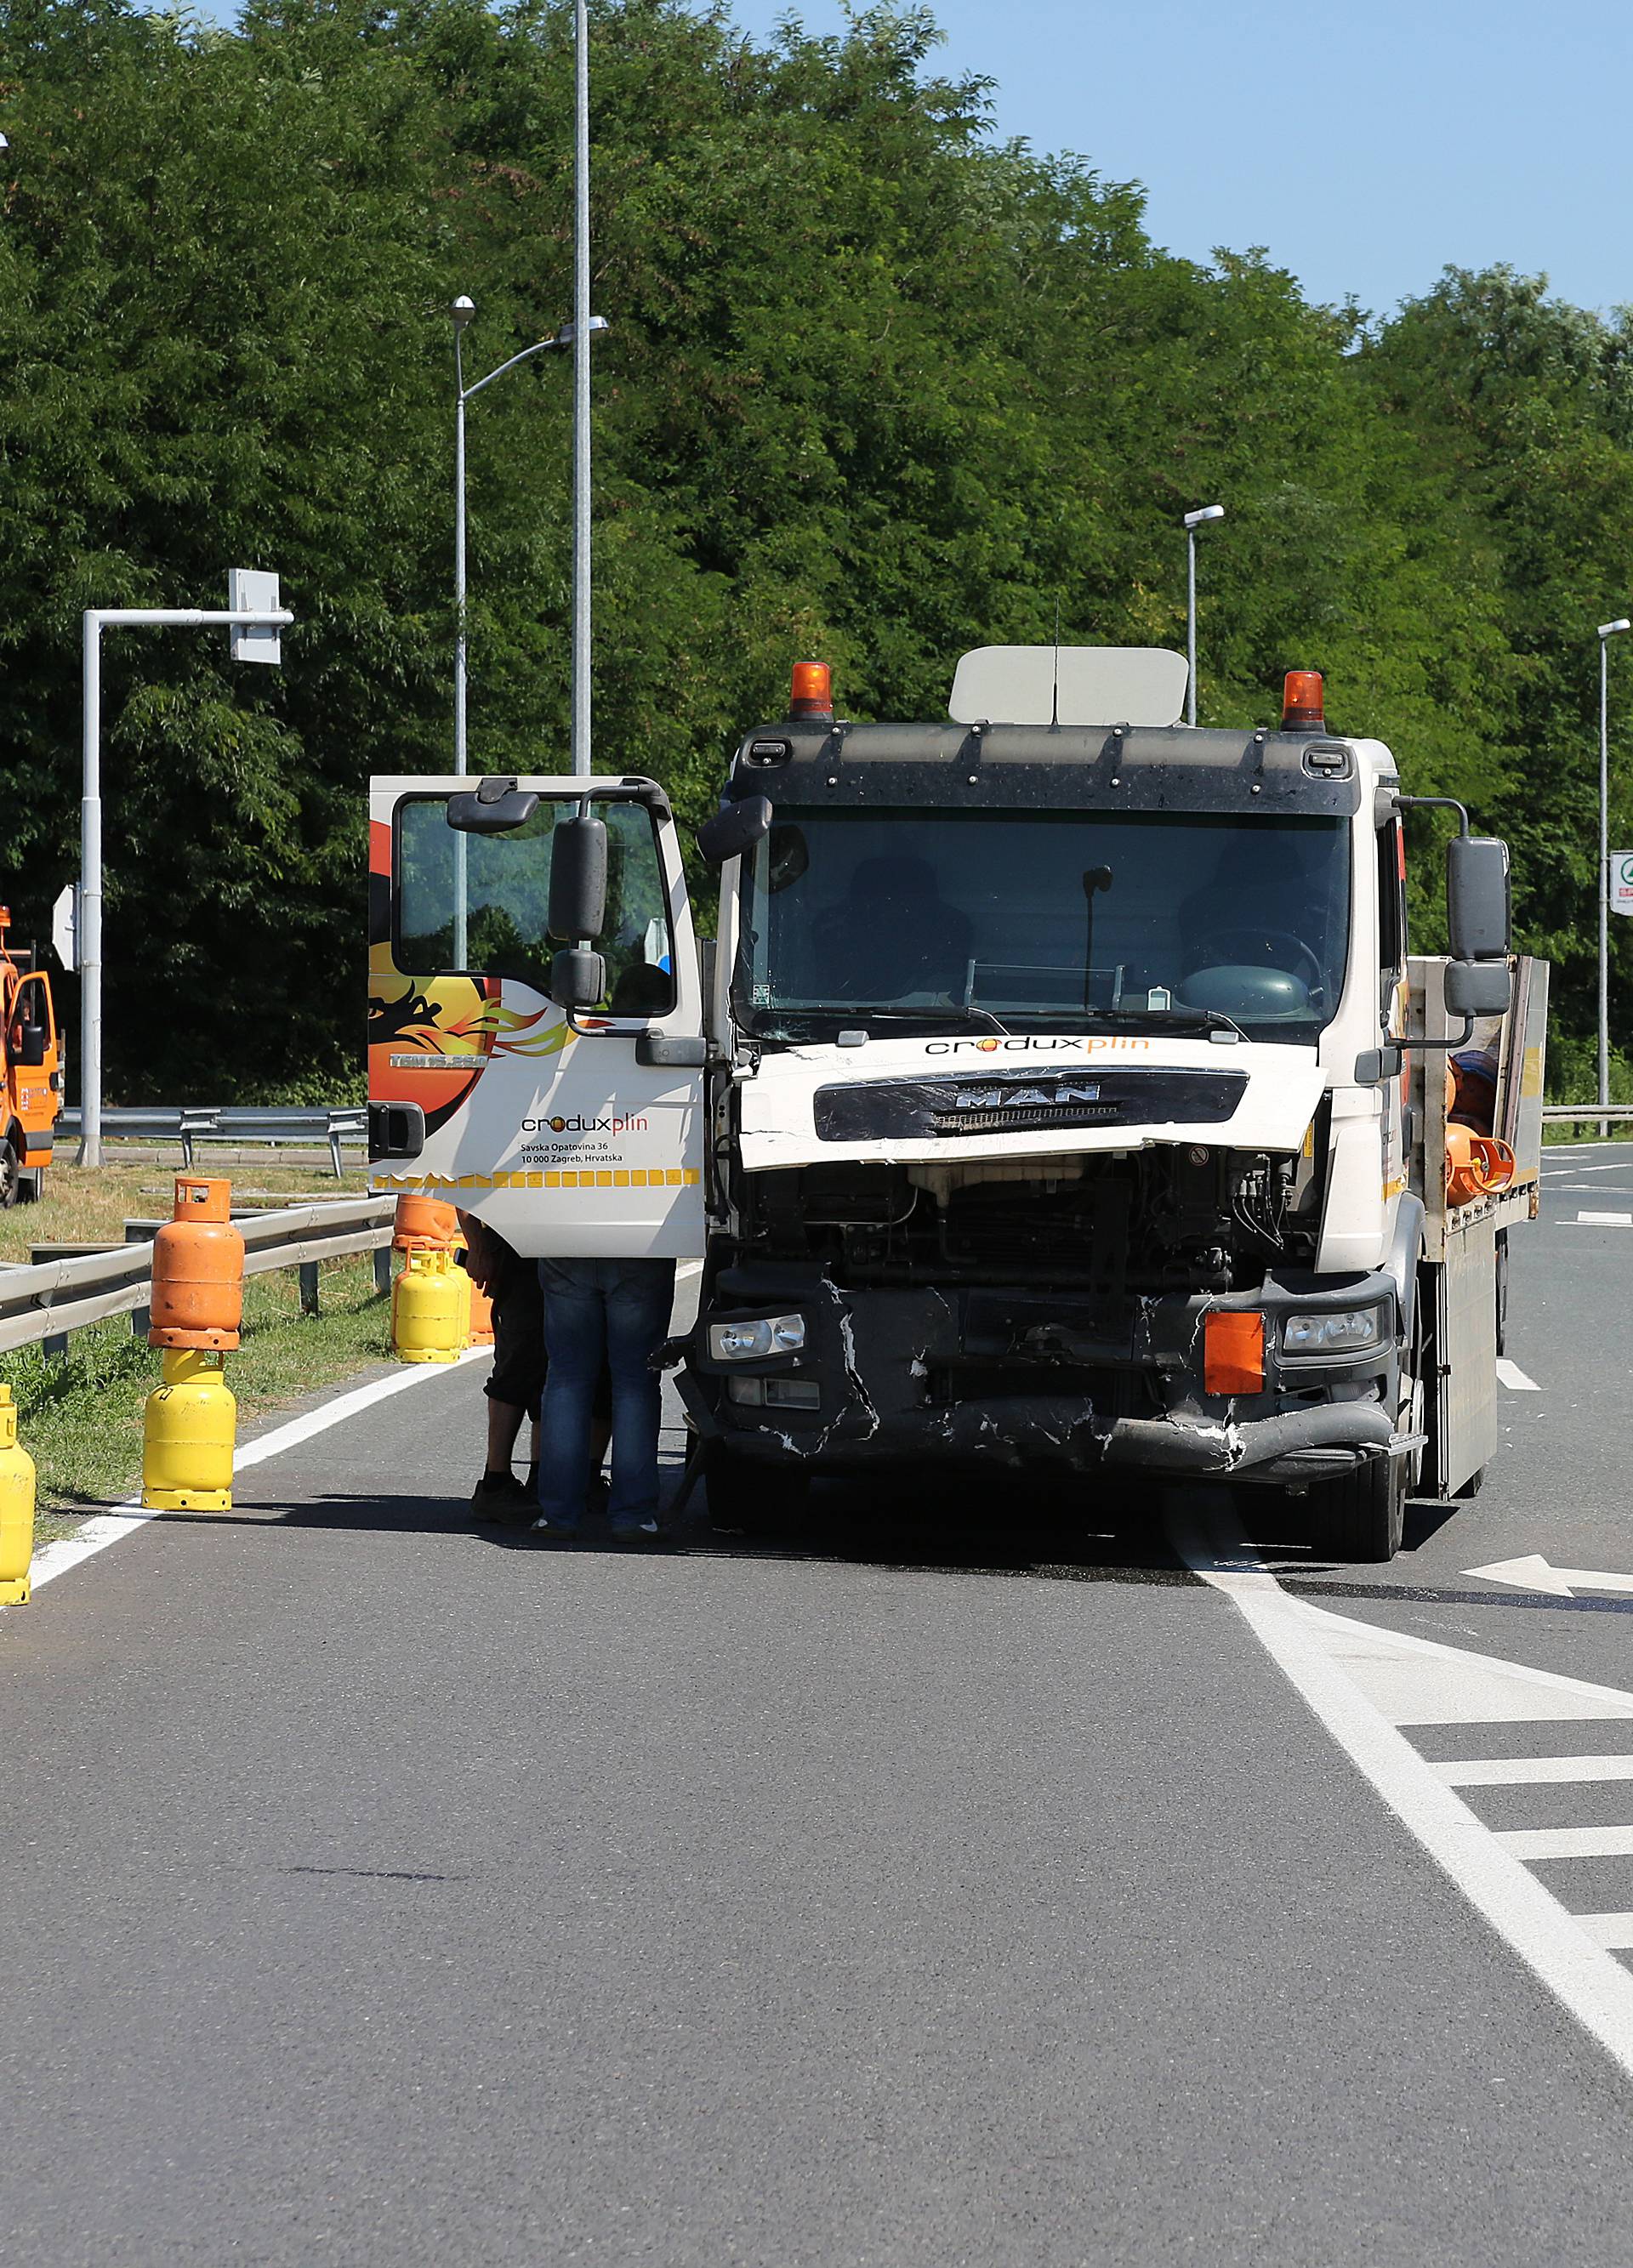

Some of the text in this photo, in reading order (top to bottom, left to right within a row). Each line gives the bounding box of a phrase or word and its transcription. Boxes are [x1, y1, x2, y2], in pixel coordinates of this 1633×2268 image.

[955, 1084, 1101, 1107] MAN
[521, 1142, 608, 1152] Savska Opatovina 36
[533, 1155, 549, 1163] 000
[551, 1154, 583, 1164] Zagreb,
[585, 1153, 623, 1162] Hrvatska
